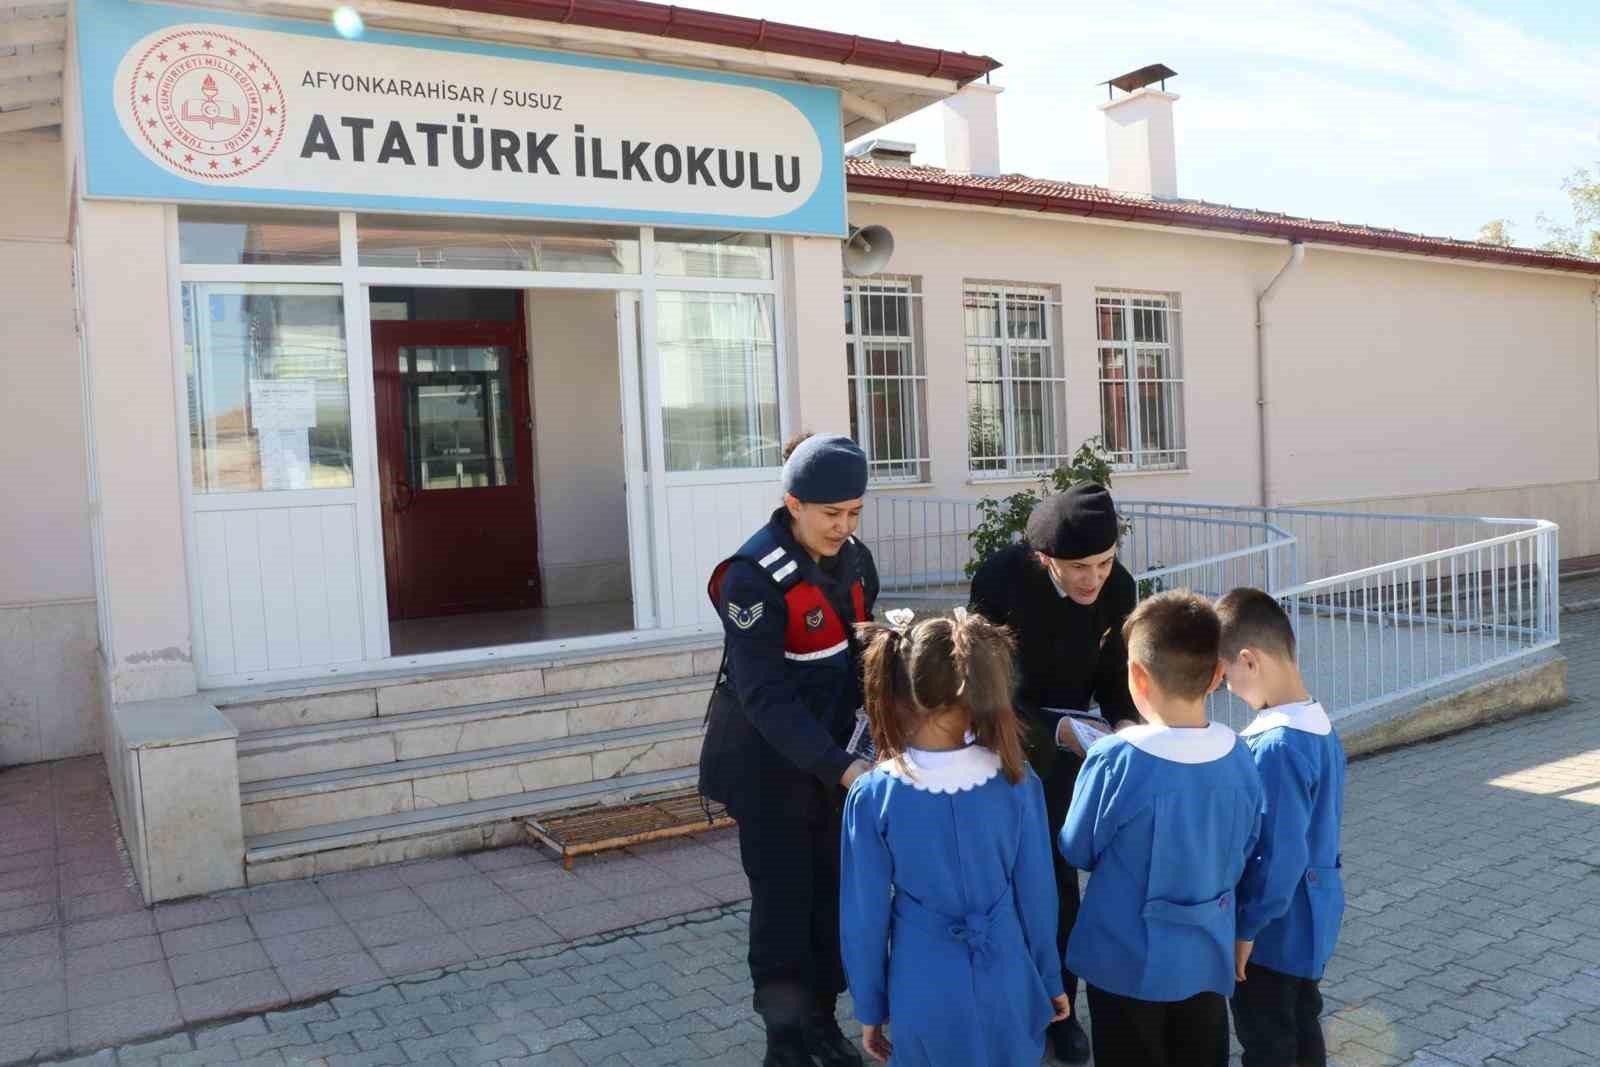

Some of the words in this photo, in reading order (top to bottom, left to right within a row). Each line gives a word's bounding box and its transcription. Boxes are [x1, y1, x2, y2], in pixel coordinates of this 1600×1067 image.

[301, 69, 484, 102] AFYONKARAHİSAR
[503, 90, 562, 111] SUSUZ
[300, 113, 560, 176] ATATÜRK
[574, 123, 801, 193] İLKOKULU
